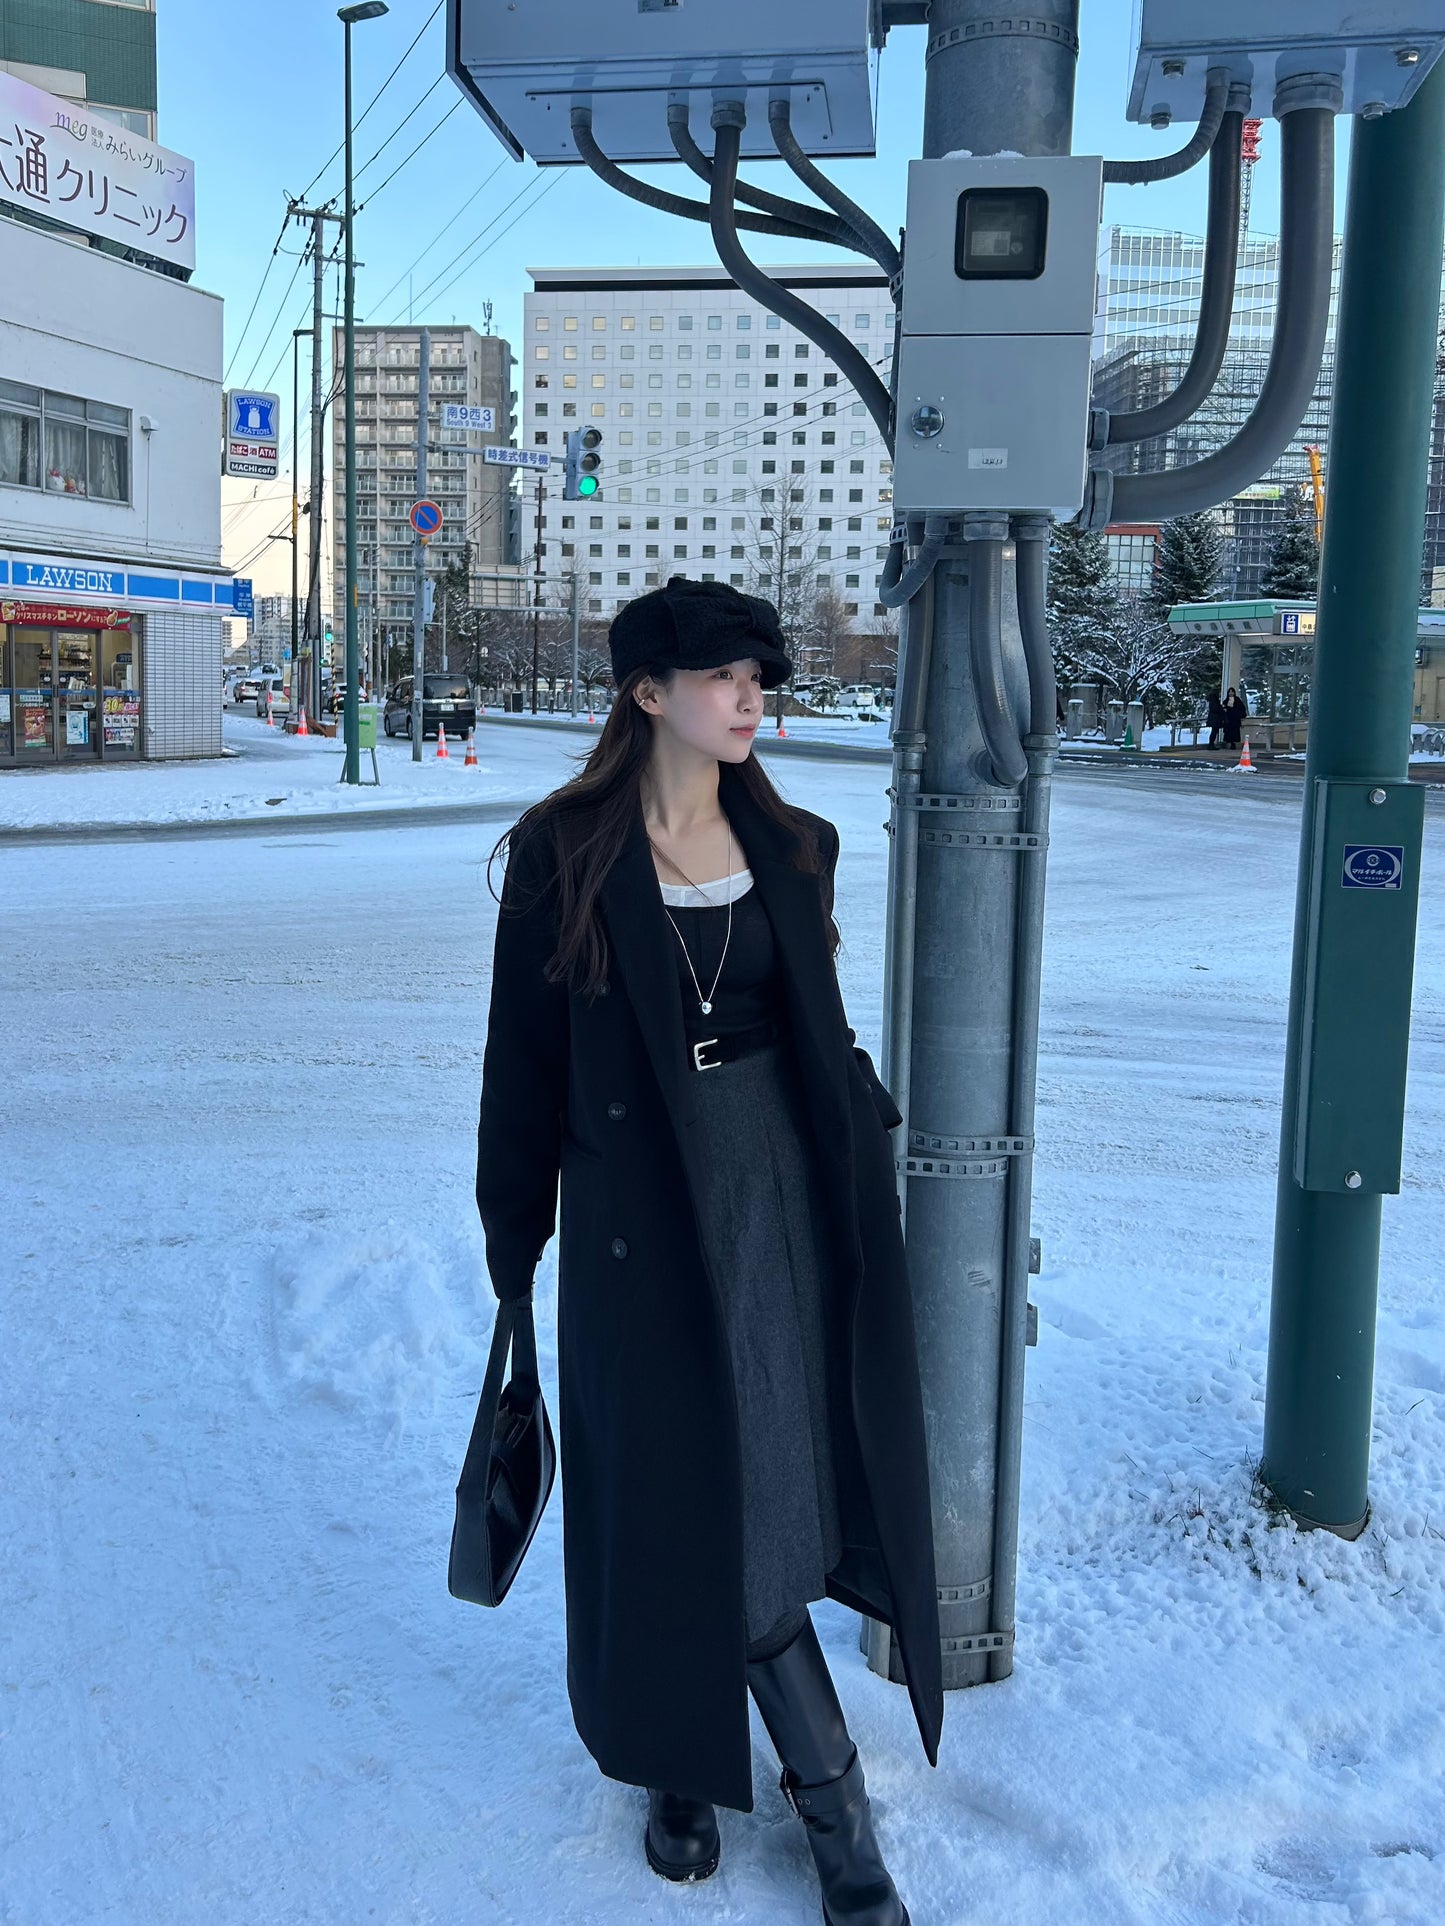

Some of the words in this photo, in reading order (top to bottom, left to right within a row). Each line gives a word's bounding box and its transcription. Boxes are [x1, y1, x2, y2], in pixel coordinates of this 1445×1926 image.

[106, 135, 187, 183] みらいグループ
[238, 398, 272, 409] LAWSON
[447, 406, 491, 422] 南9西3
[237, 425, 270, 436] STATION
[231, 444, 248, 456] たばこ
[259, 448, 276, 458] ATM
[488, 449, 549, 465] 時差式信号機
[231, 463, 257, 473] MACHI
[26, 565, 113, 593] LAWSON
